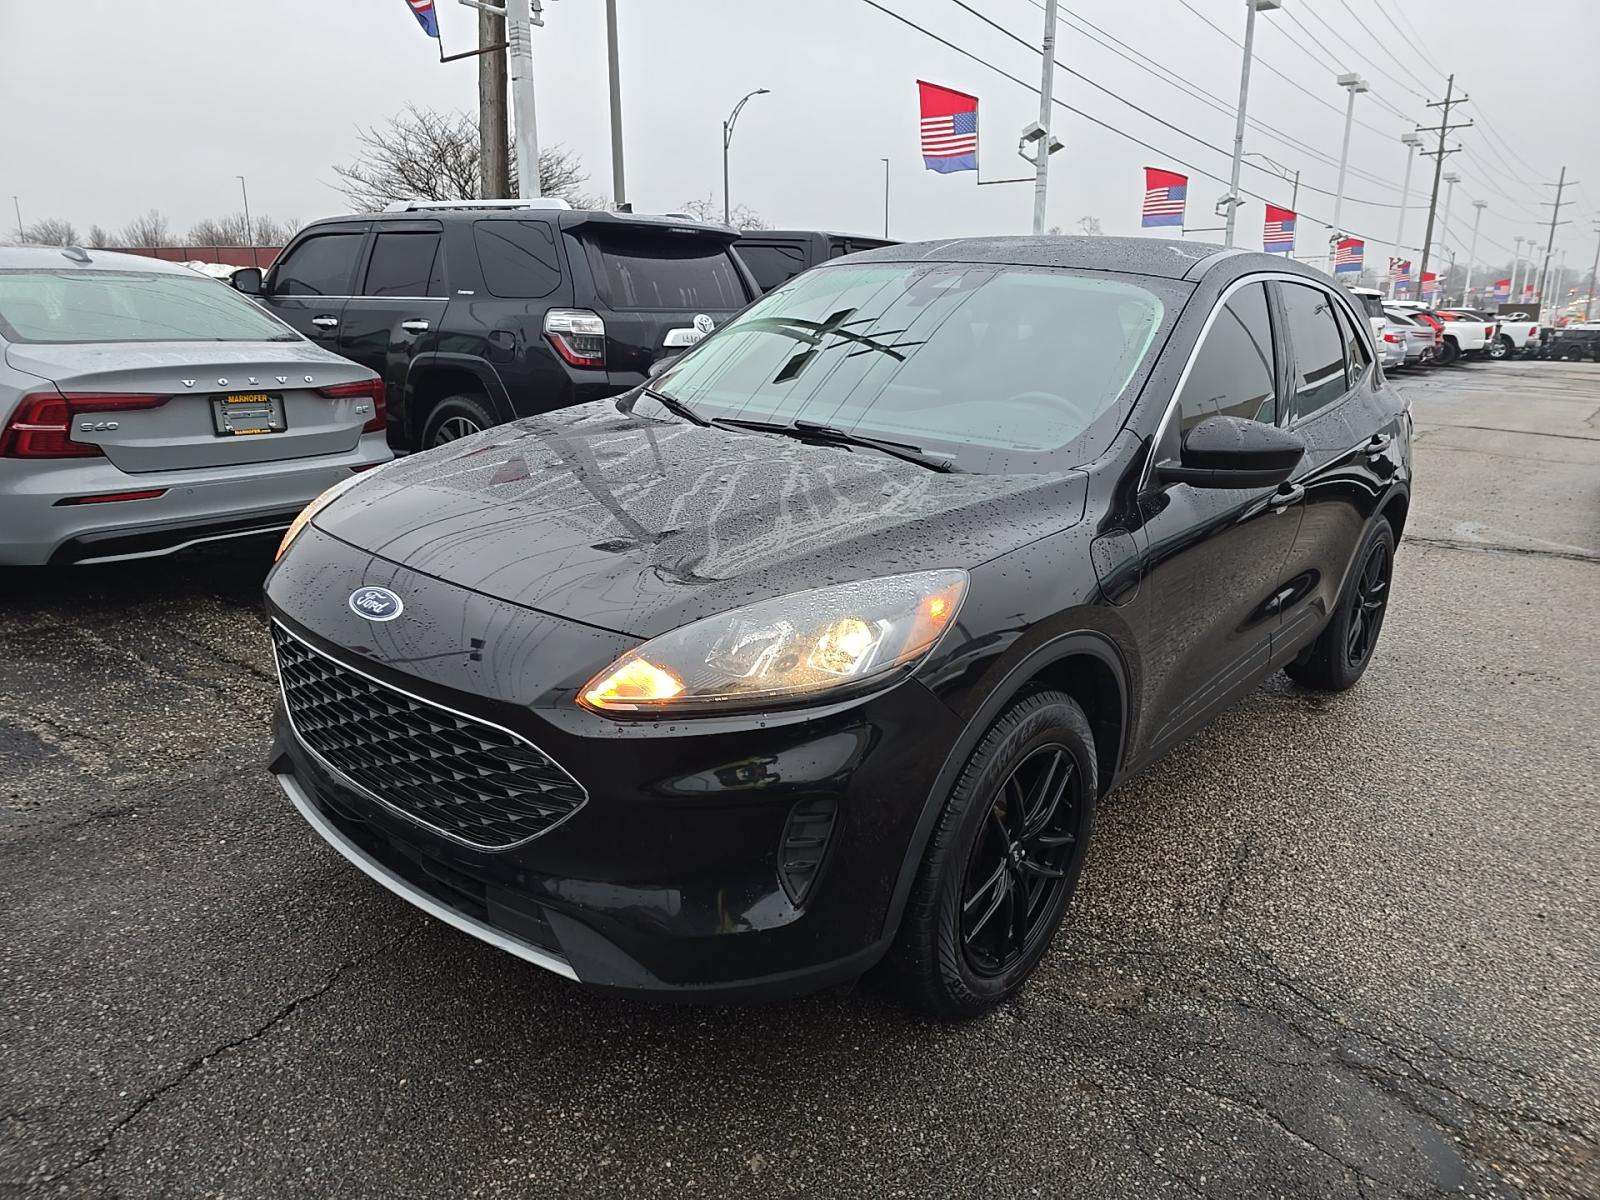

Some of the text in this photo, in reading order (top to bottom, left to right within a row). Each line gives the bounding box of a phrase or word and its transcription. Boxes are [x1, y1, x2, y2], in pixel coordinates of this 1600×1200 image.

[181, 375, 314, 388] VOLVO
[228, 394, 268, 404] MARHOFER
[80, 422, 119, 432] S60
[356, 591, 390, 614] Ford
